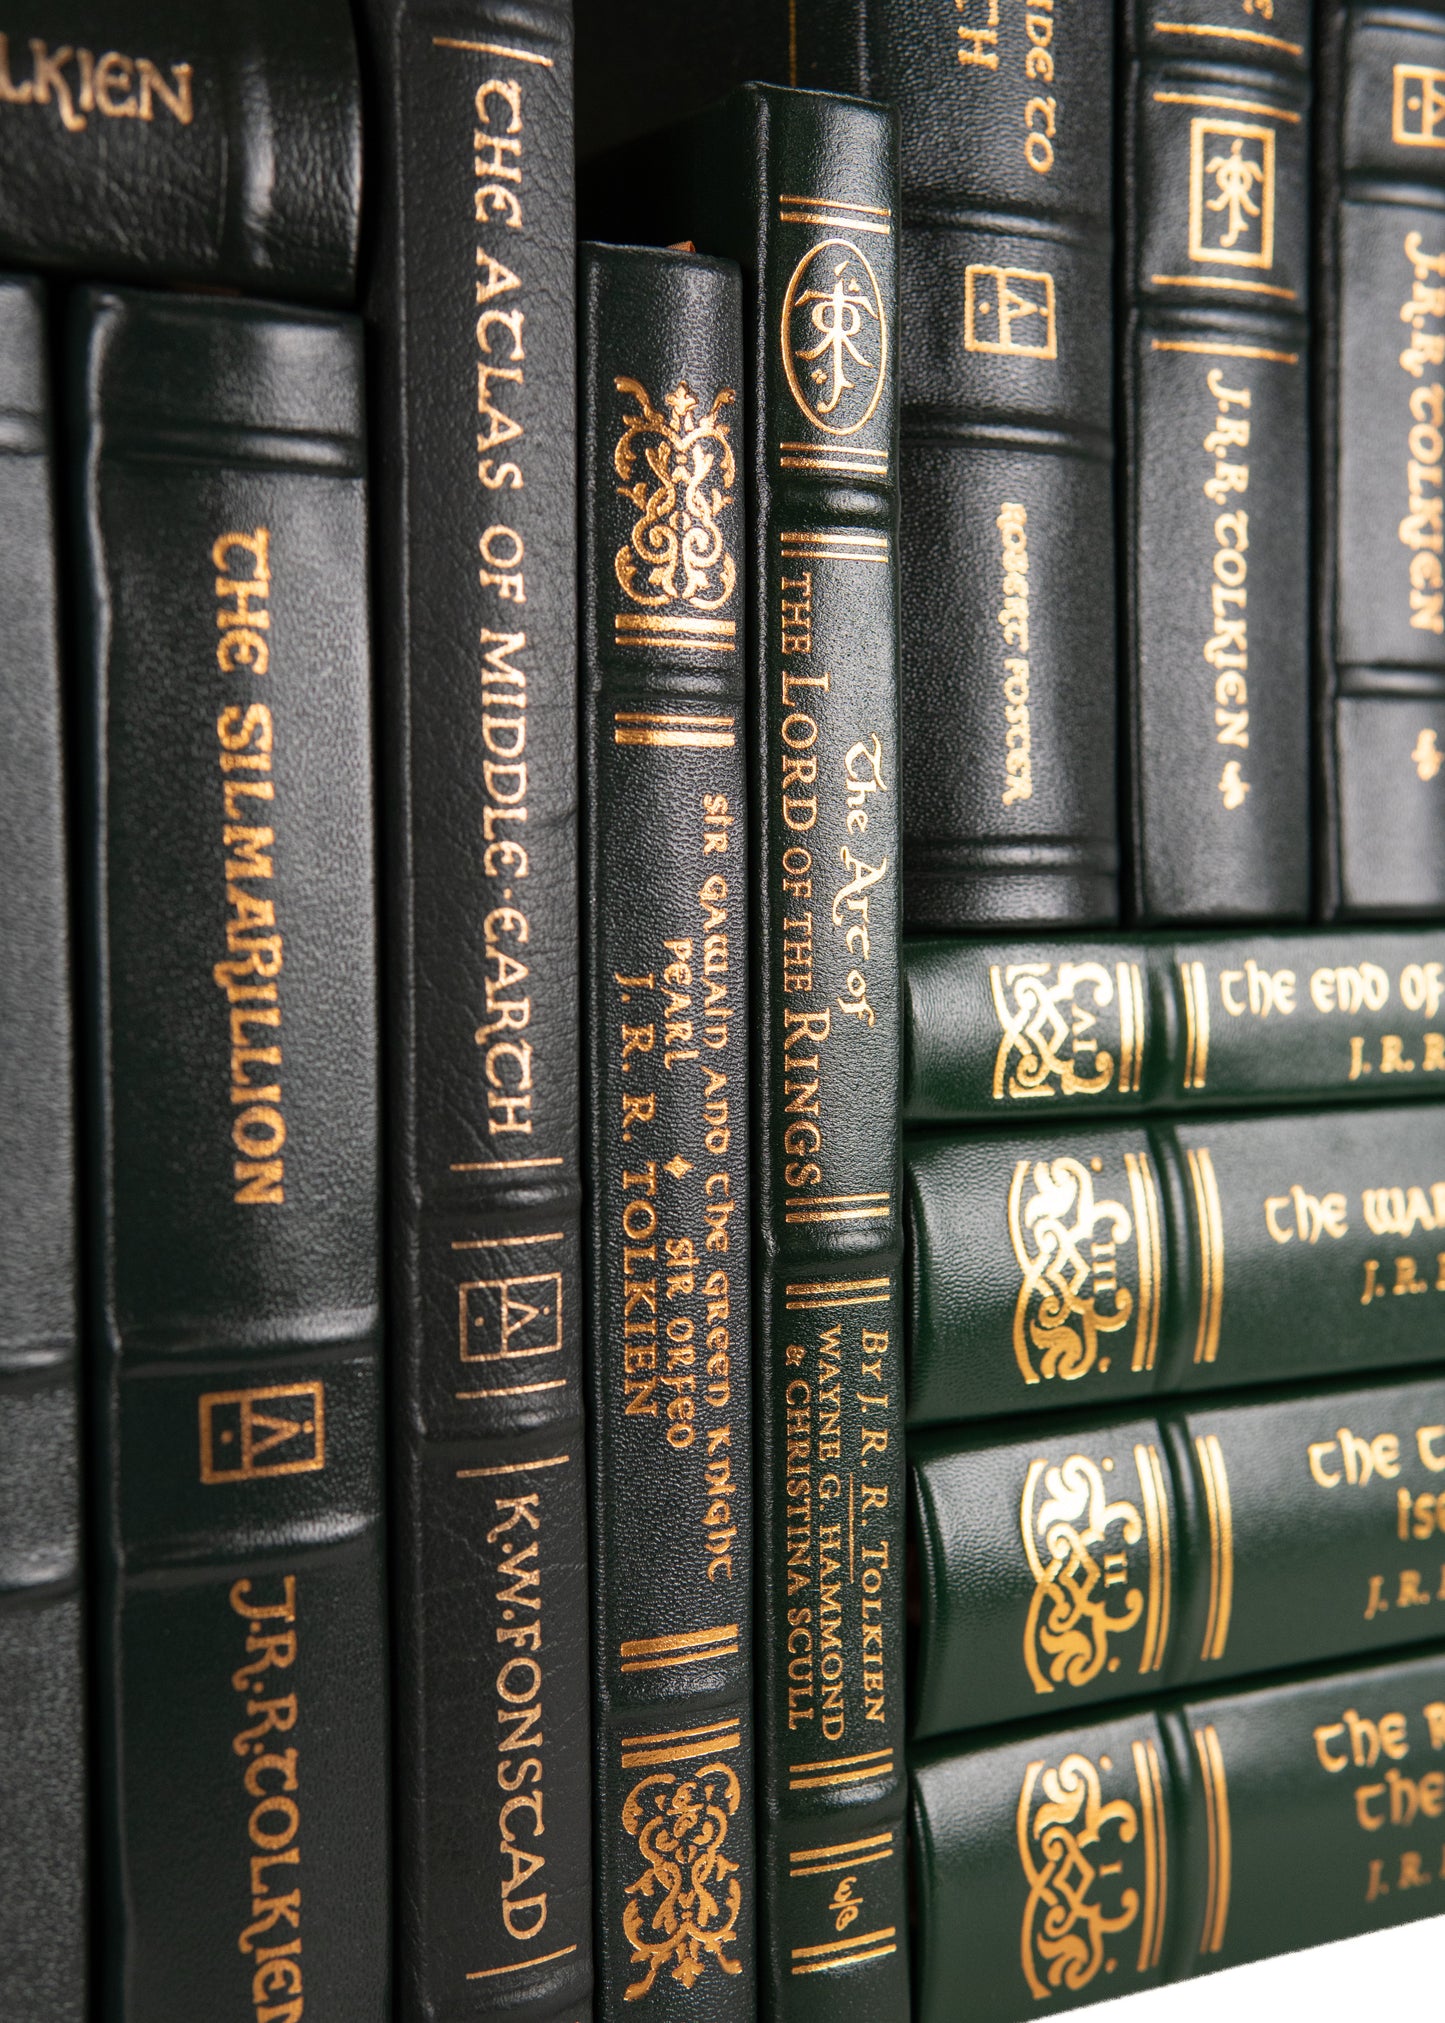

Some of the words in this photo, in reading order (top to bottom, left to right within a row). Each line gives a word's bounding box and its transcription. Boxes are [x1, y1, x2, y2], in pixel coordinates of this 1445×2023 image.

[475, 246, 525, 491] ATLAS
[212, 527, 271, 675] THE
[479, 524, 526, 604] OF
[1204, 508, 1250, 748] TOLKIEN
[844, 732, 888, 833] The
[1001, 658, 1032, 806] FOSTER
[213, 703, 287, 1206] SILMARILLION
[835, 968, 877, 1028] of
[622, 1160, 660, 1416] TOLKIEN
[819, 1324, 842, 1462] WAYNE
[786, 1378, 814, 1597] CHRISTINA
[818, 1472, 843, 1512] G.
[787, 1606, 815, 1732] SCULL
[819, 1524, 845, 1742] HAMMOND
